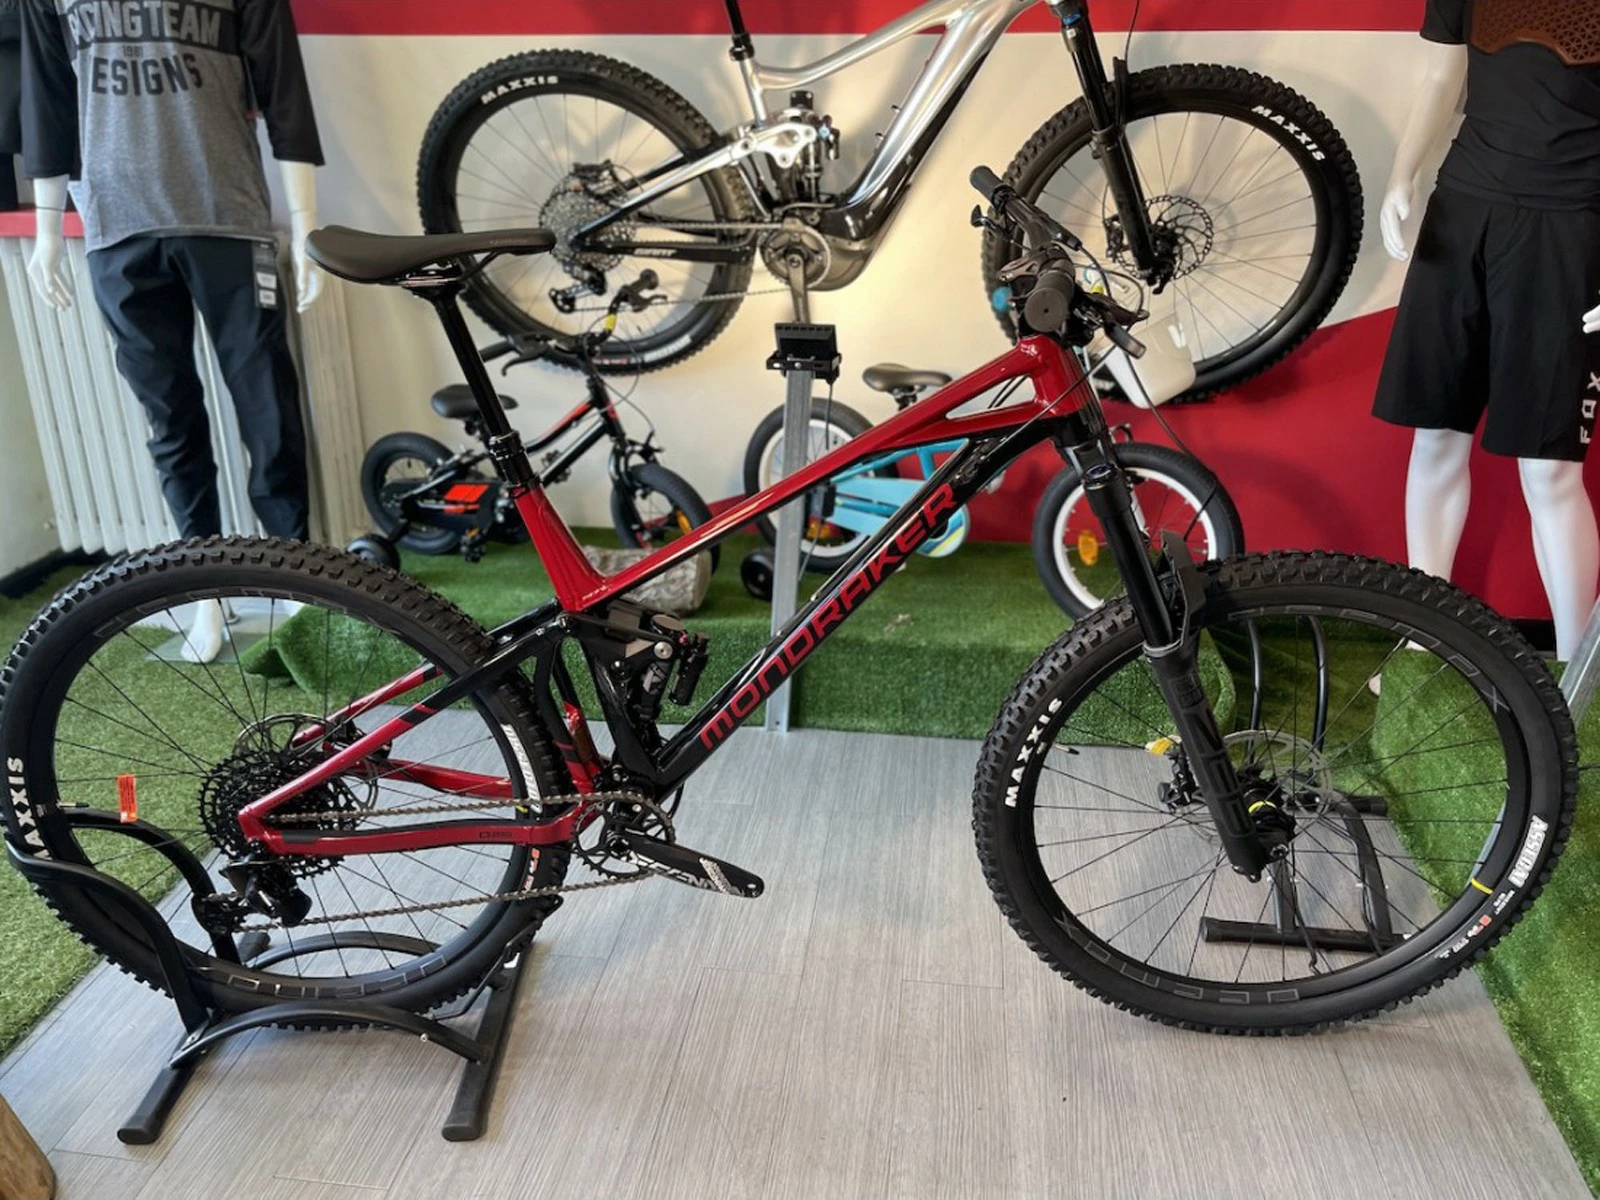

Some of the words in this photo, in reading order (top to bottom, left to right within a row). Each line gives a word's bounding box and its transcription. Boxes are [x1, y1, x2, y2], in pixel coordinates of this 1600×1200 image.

[143, 1, 221, 46] TEAM
[480, 75, 559, 105] MAXXIS
[1251, 104, 1327, 162] MAXXIS
[1579, 371, 1600, 444] FOX
[699, 482, 959, 752] MONDRAKER
[1005, 698, 1062, 808] MAXXIS
